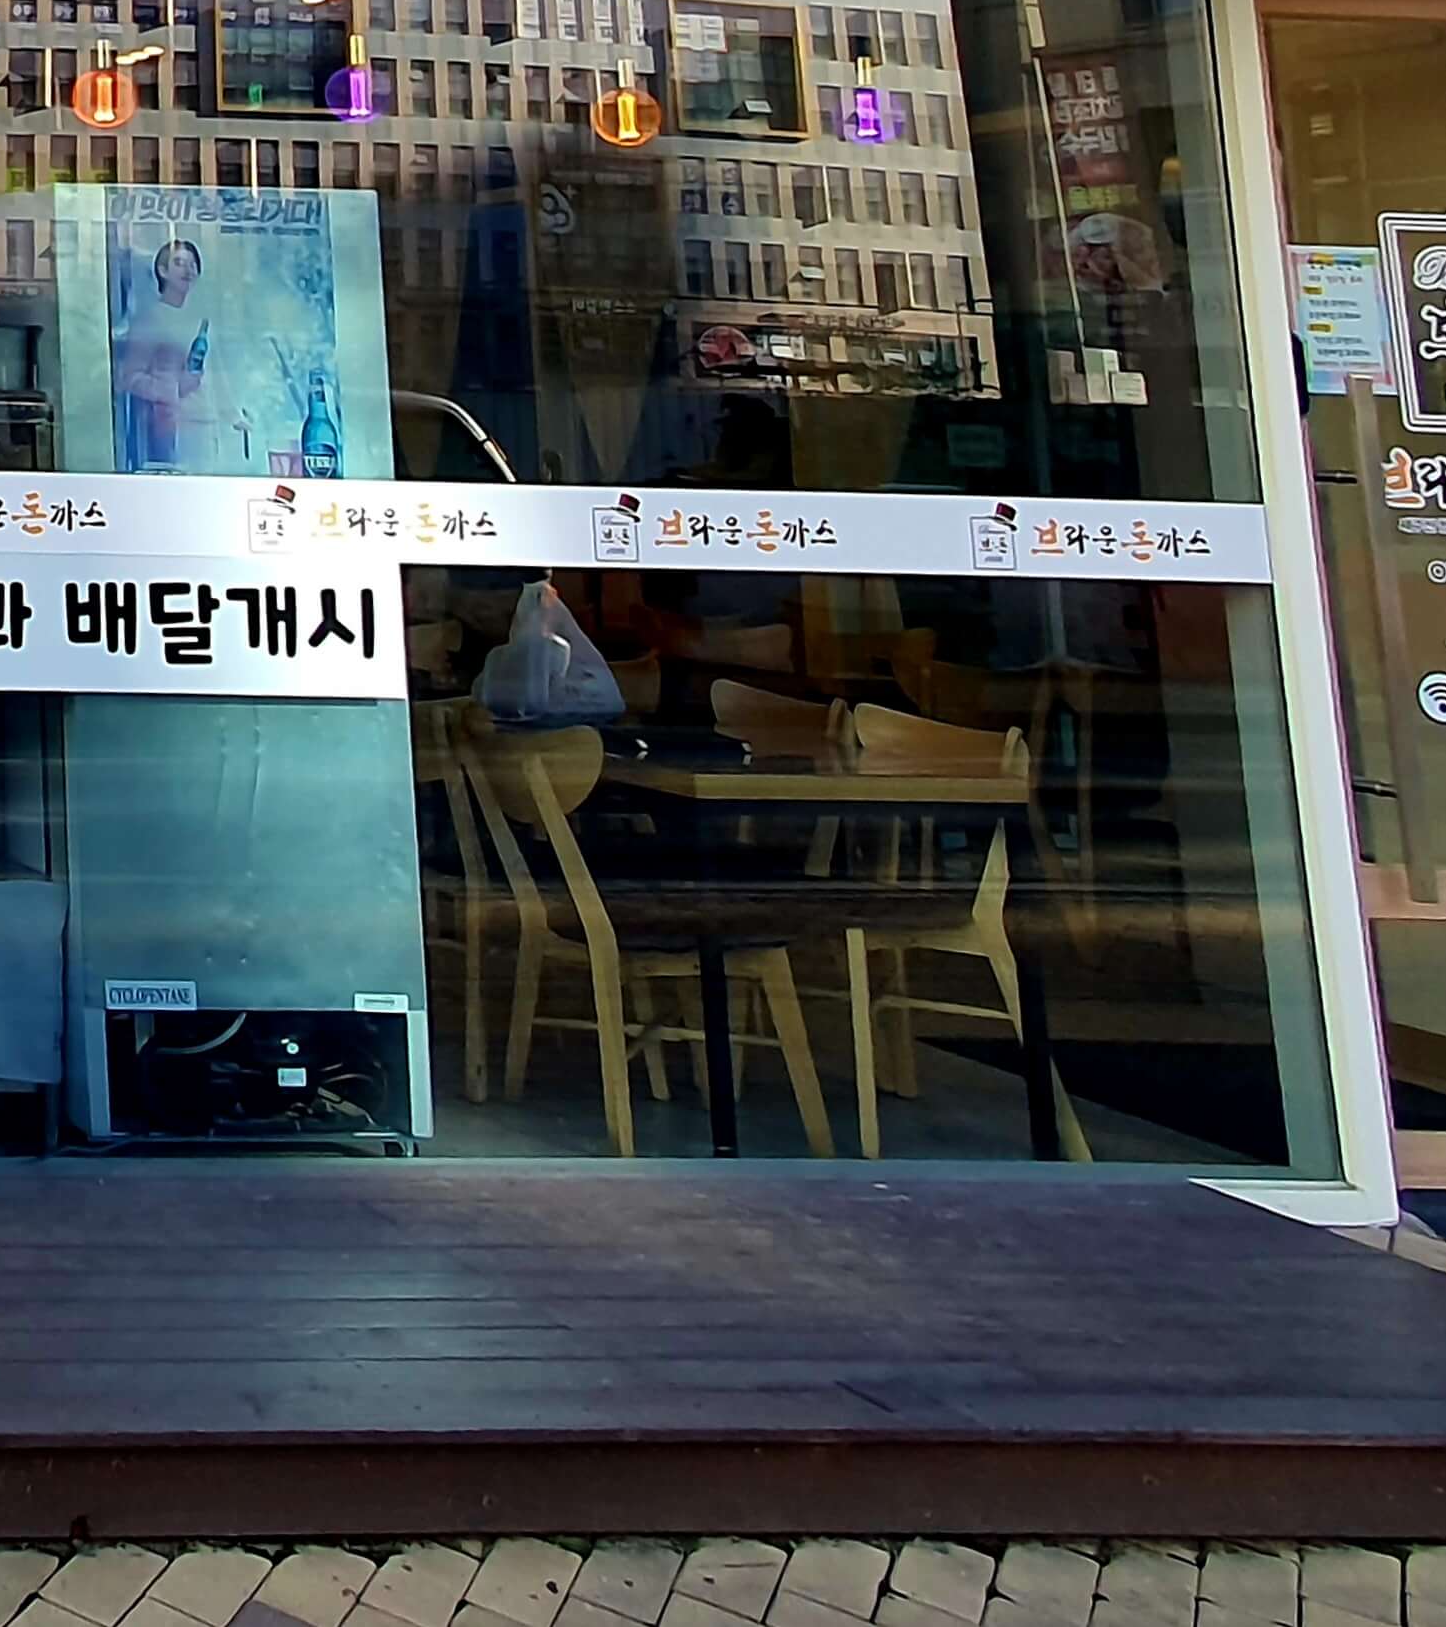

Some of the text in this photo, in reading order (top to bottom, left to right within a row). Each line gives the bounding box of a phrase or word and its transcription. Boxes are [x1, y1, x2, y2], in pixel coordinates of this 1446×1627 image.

[653, 509, 838, 553] 브라운돈까스
[1030, 518, 1212, 562] 브라운돈까스
[64, 580, 376, 665] 배달개시
